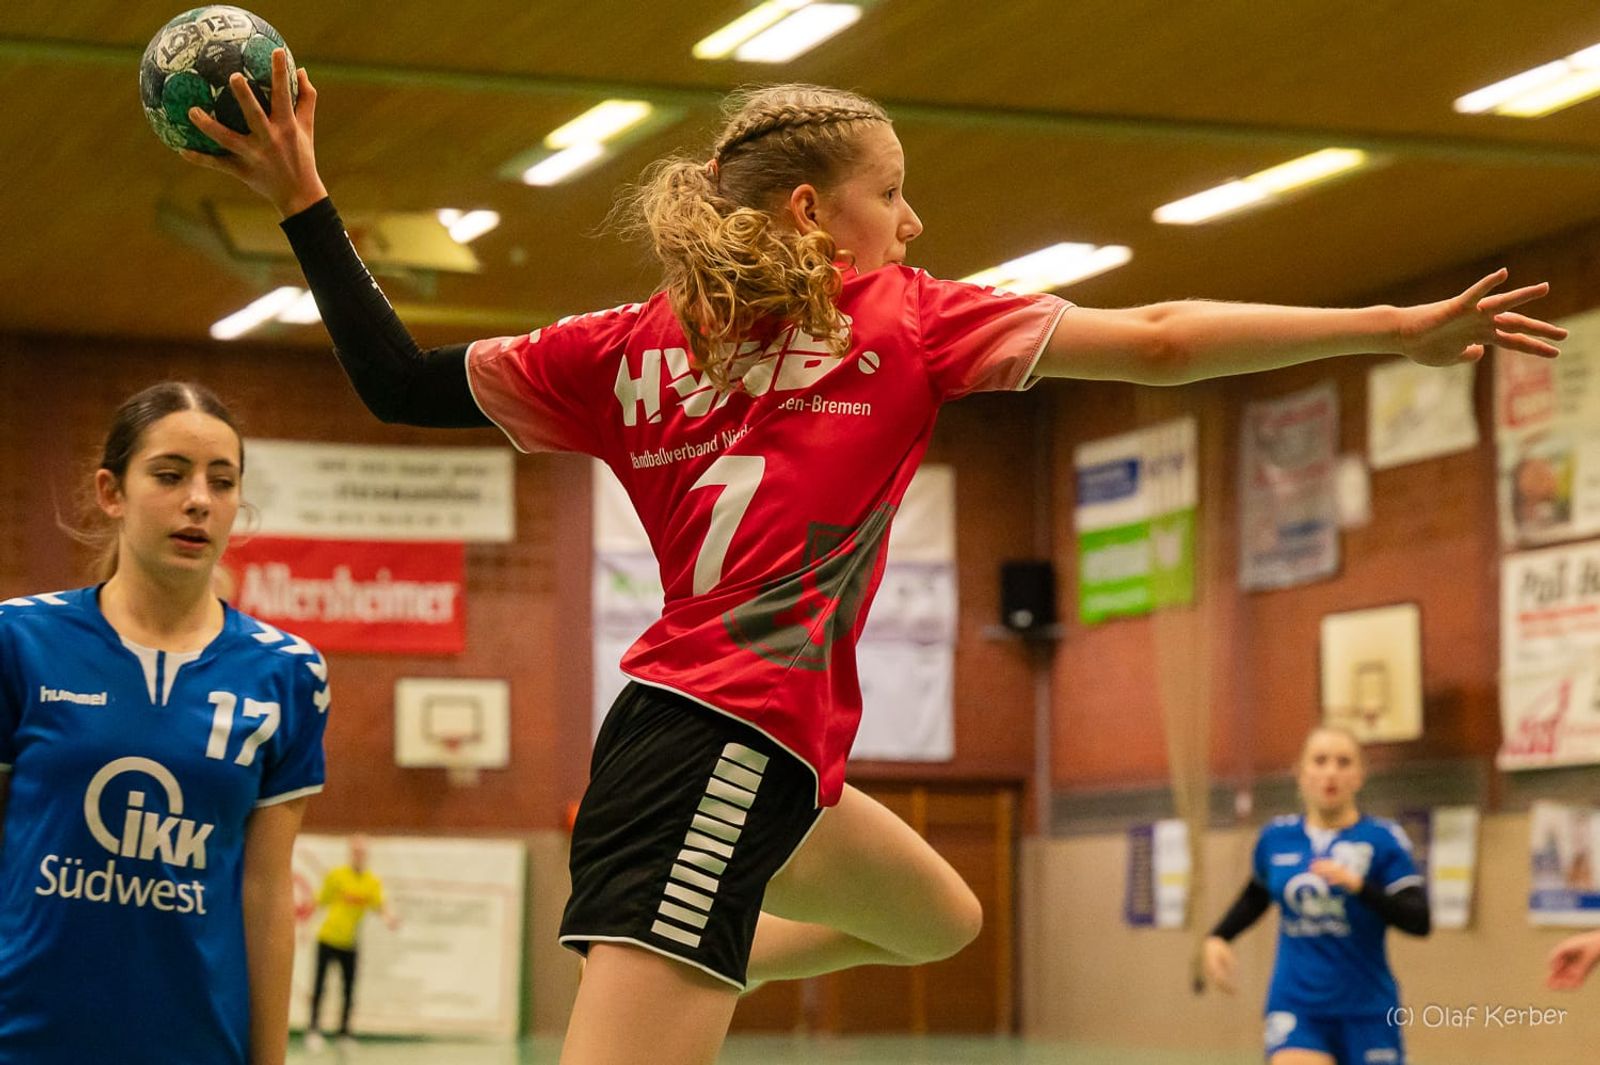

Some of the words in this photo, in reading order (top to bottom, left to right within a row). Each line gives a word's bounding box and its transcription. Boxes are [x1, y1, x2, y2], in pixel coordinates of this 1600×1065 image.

[689, 455, 766, 597] 7
[40, 685, 107, 705] hummel
[205, 691, 281, 767] 17
[35, 853, 207, 915] Südwest
